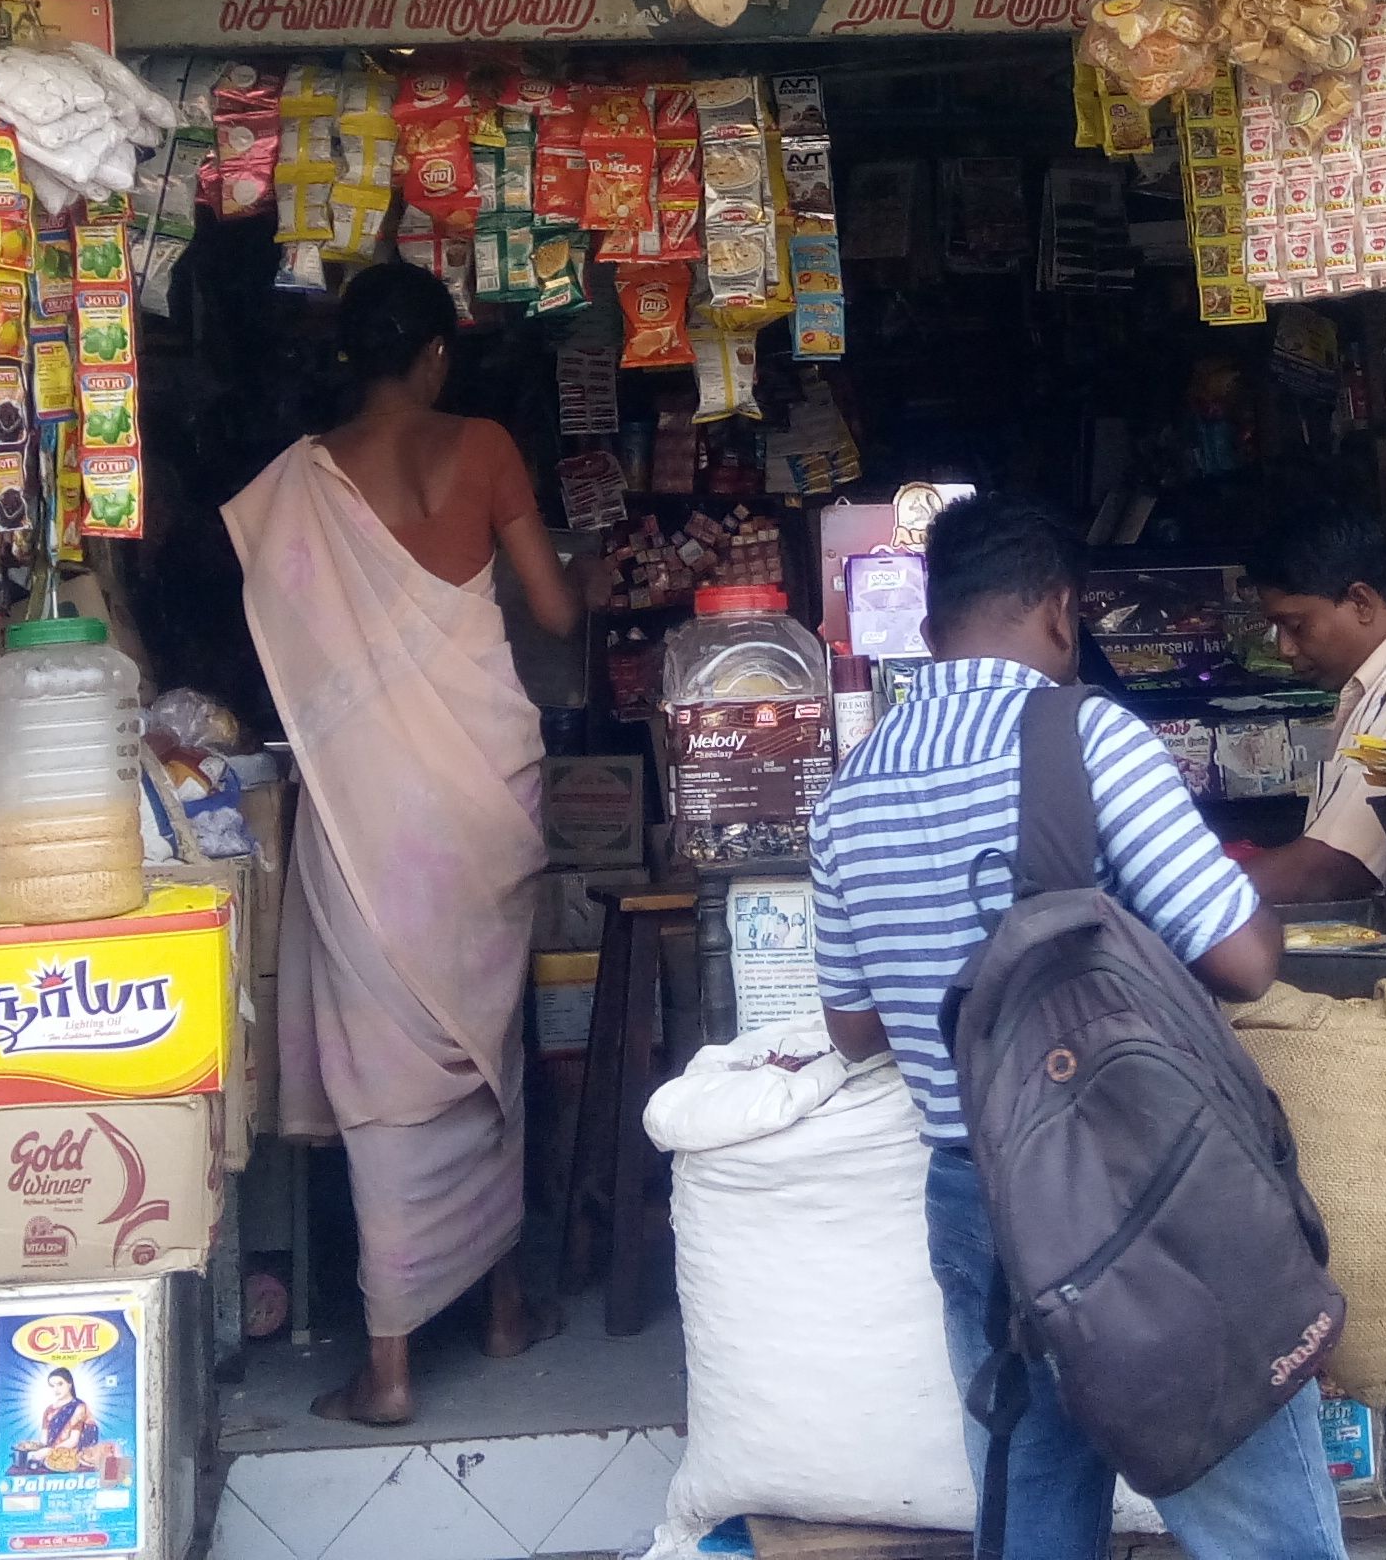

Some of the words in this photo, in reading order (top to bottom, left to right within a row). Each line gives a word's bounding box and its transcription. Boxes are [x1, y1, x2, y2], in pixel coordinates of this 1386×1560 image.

[779, 78, 816, 91] AVT
[787, 151, 825, 166] AVT
[85, 294, 122, 306] JOTHI
[88, 377, 126, 389] JOTHI
[90, 461, 129, 473] JOTHI
[687, 730, 747, 753] Melody
[64, 1019, 105, 1031] Lighting
[106, 1016, 122, 1027] Oil
[7, 1127, 94, 1192] Gold
[26, 1322, 101, 1354] CM
